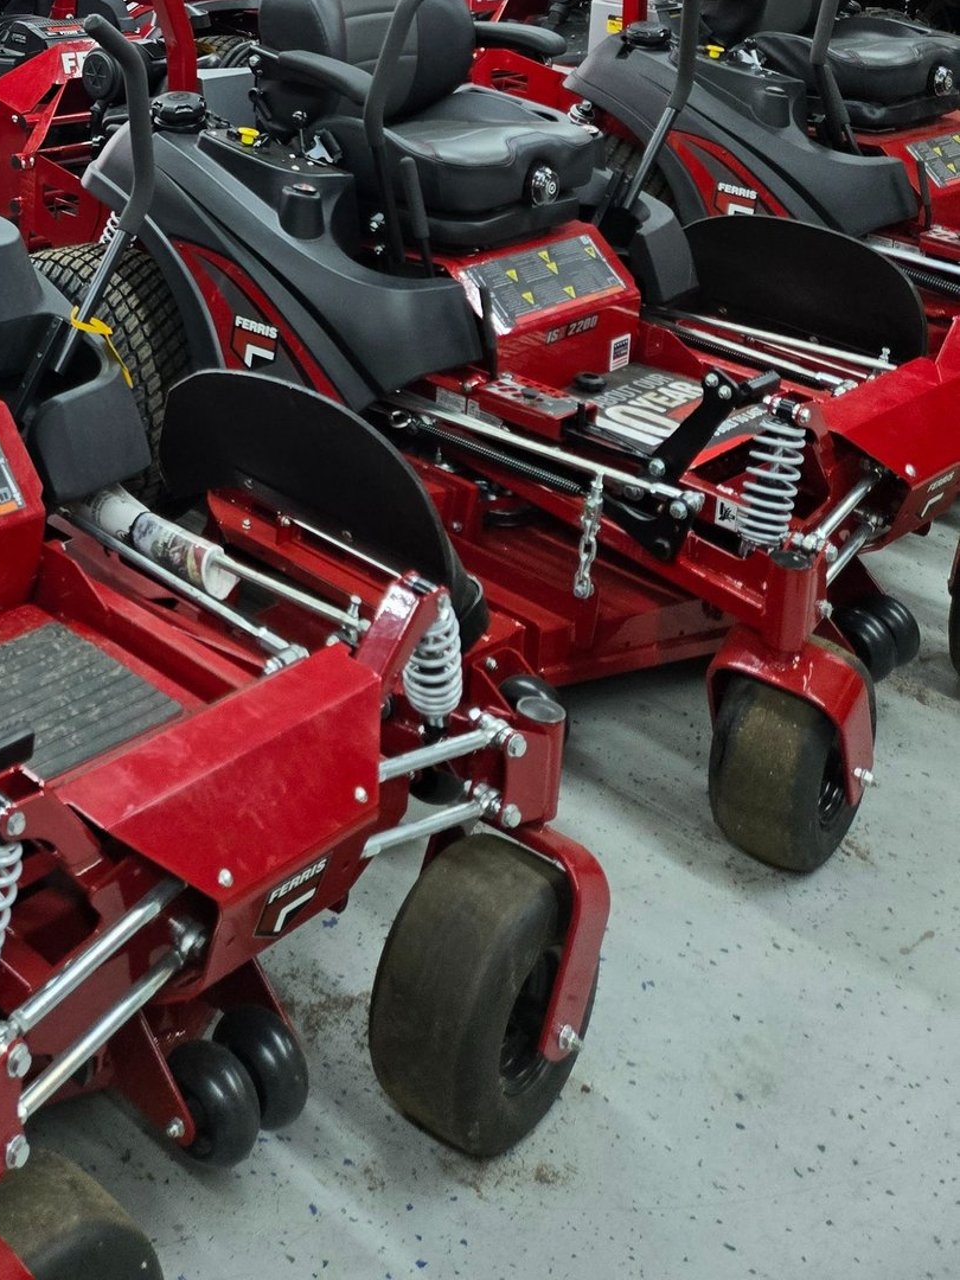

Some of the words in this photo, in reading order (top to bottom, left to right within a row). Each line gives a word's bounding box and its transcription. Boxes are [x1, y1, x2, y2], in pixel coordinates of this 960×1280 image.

[718, 181, 757, 200] FERRIS
[235, 315, 278, 339] FERRIS
[568, 315, 599, 336] 2200
[594, 384, 641, 410] ABOUT
[628, 381, 704, 413] YEAR
[595, 404, 681, 446] 10
[267, 856, 329, 905] FERRIS
